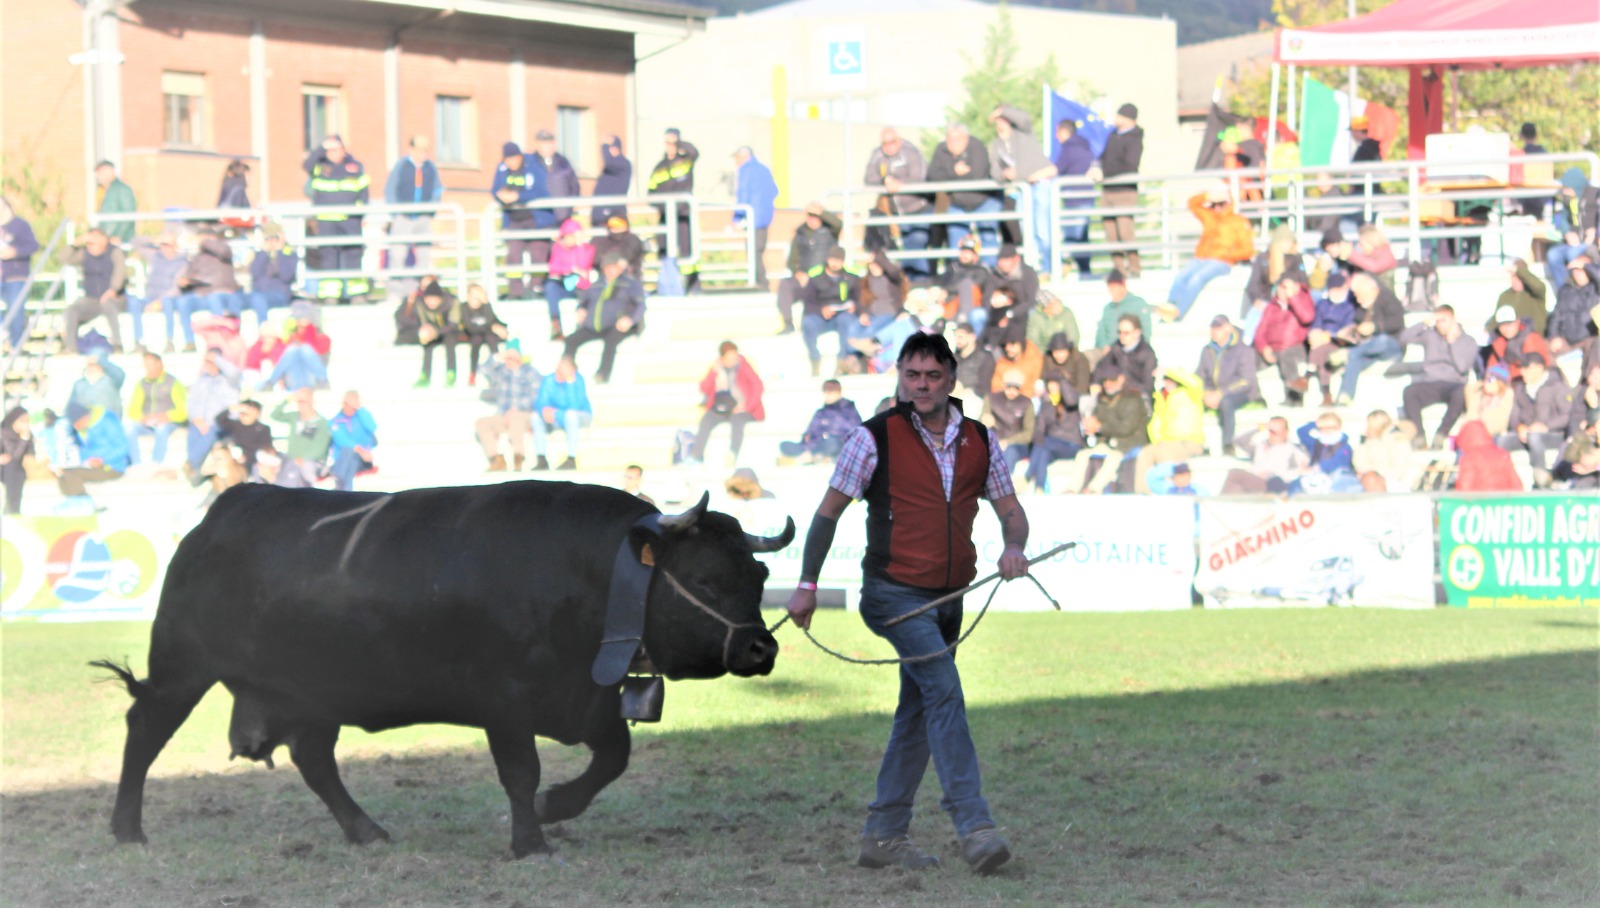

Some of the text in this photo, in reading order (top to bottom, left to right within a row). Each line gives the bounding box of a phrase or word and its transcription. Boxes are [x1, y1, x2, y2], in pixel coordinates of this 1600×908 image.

[1208, 509, 1315, 572] GIACHINO
[1451, 505, 1545, 543] CONFIDI
[1493, 548, 1562, 586] VALLE
